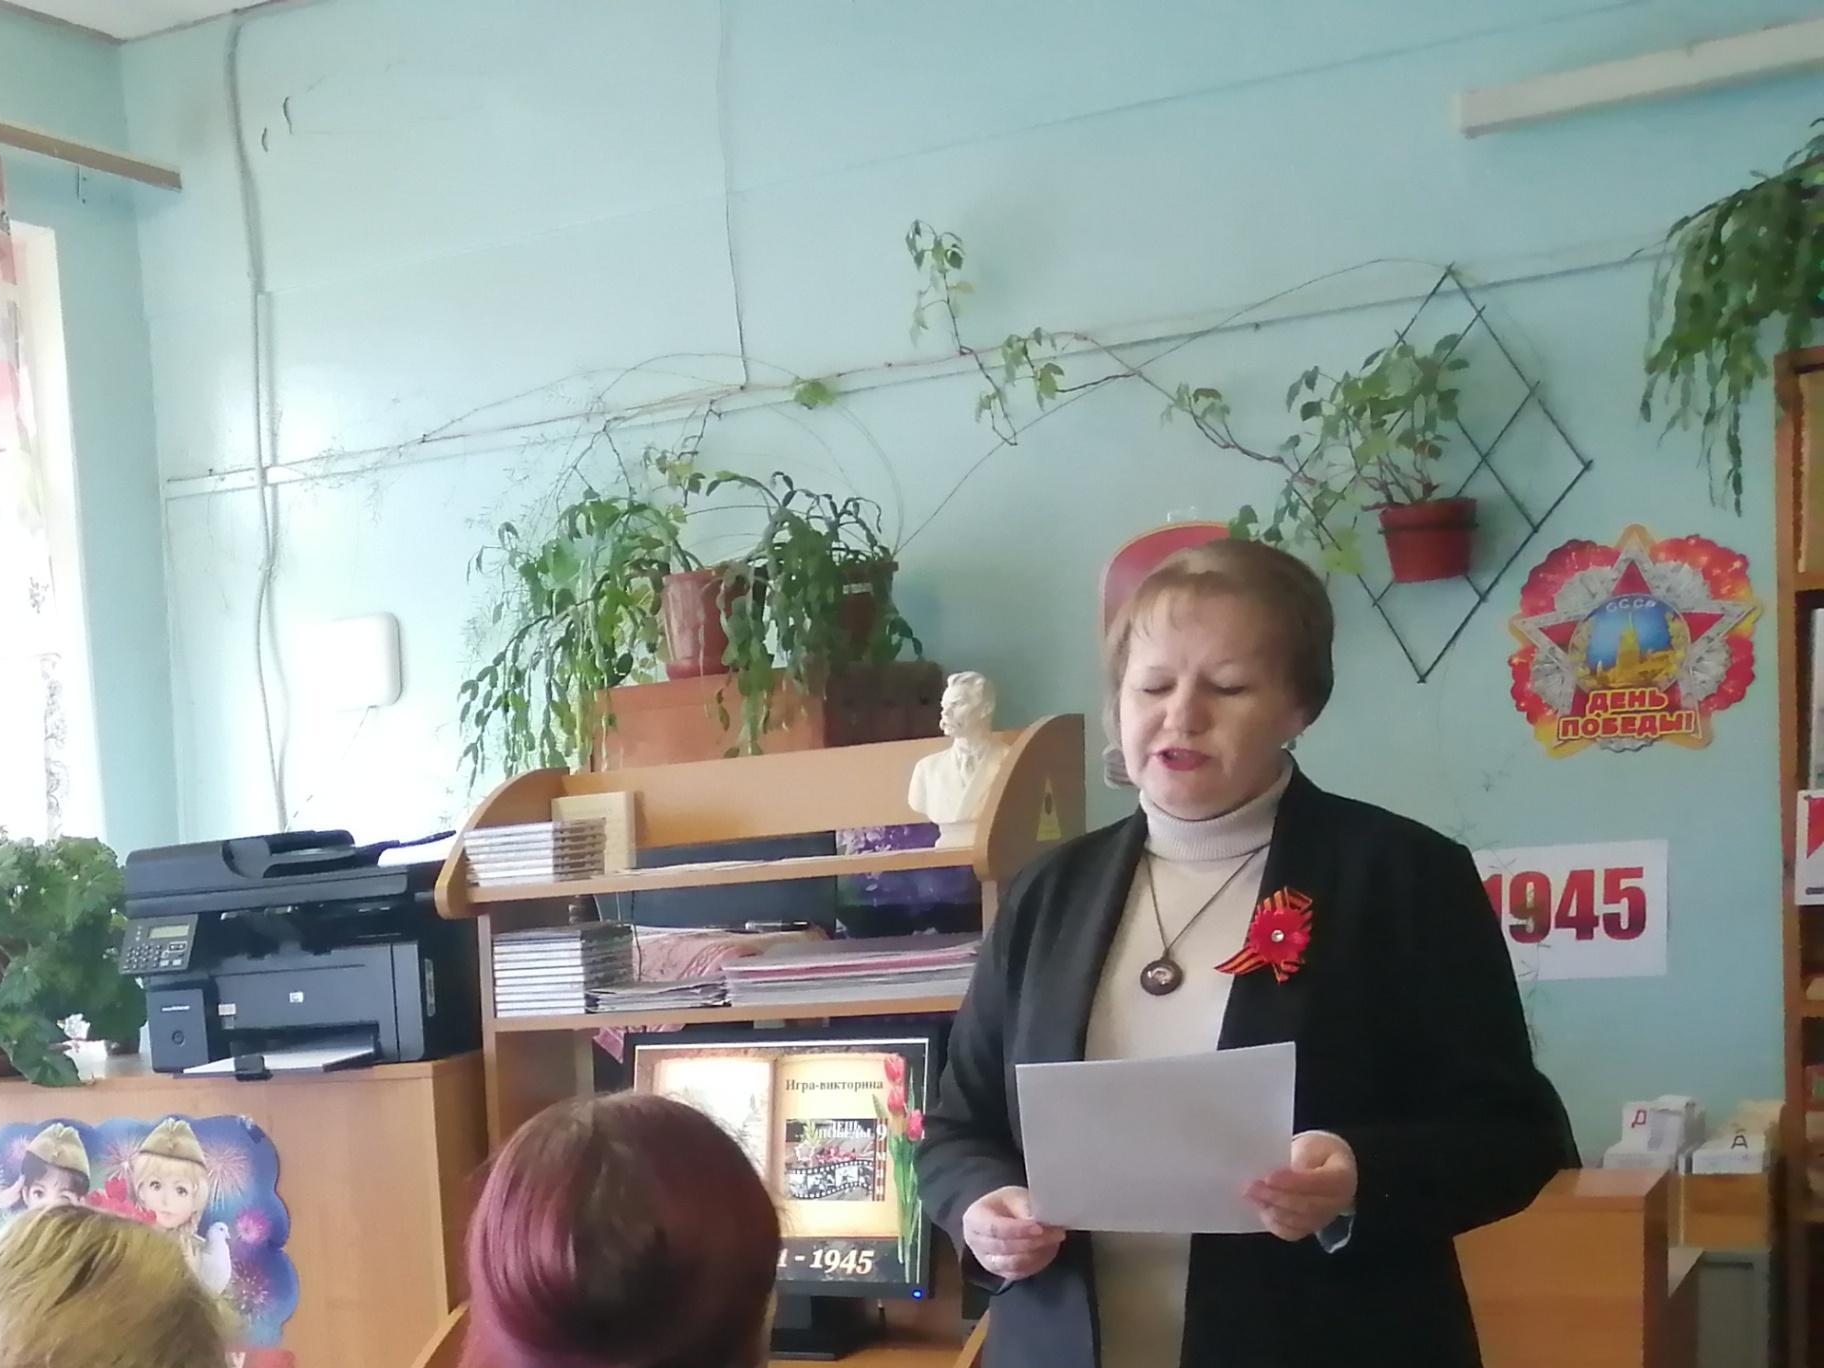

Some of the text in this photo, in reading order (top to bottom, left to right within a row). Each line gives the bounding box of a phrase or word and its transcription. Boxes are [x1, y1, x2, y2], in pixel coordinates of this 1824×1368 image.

[1587, 688, 1668, 714] ДЕНЬ
[1559, 711, 1695, 740] ПОБЕДЫ!
[785, 1079, 884, 1093] Игра-викторина
[809, 1248, 875, 1275] 1945
